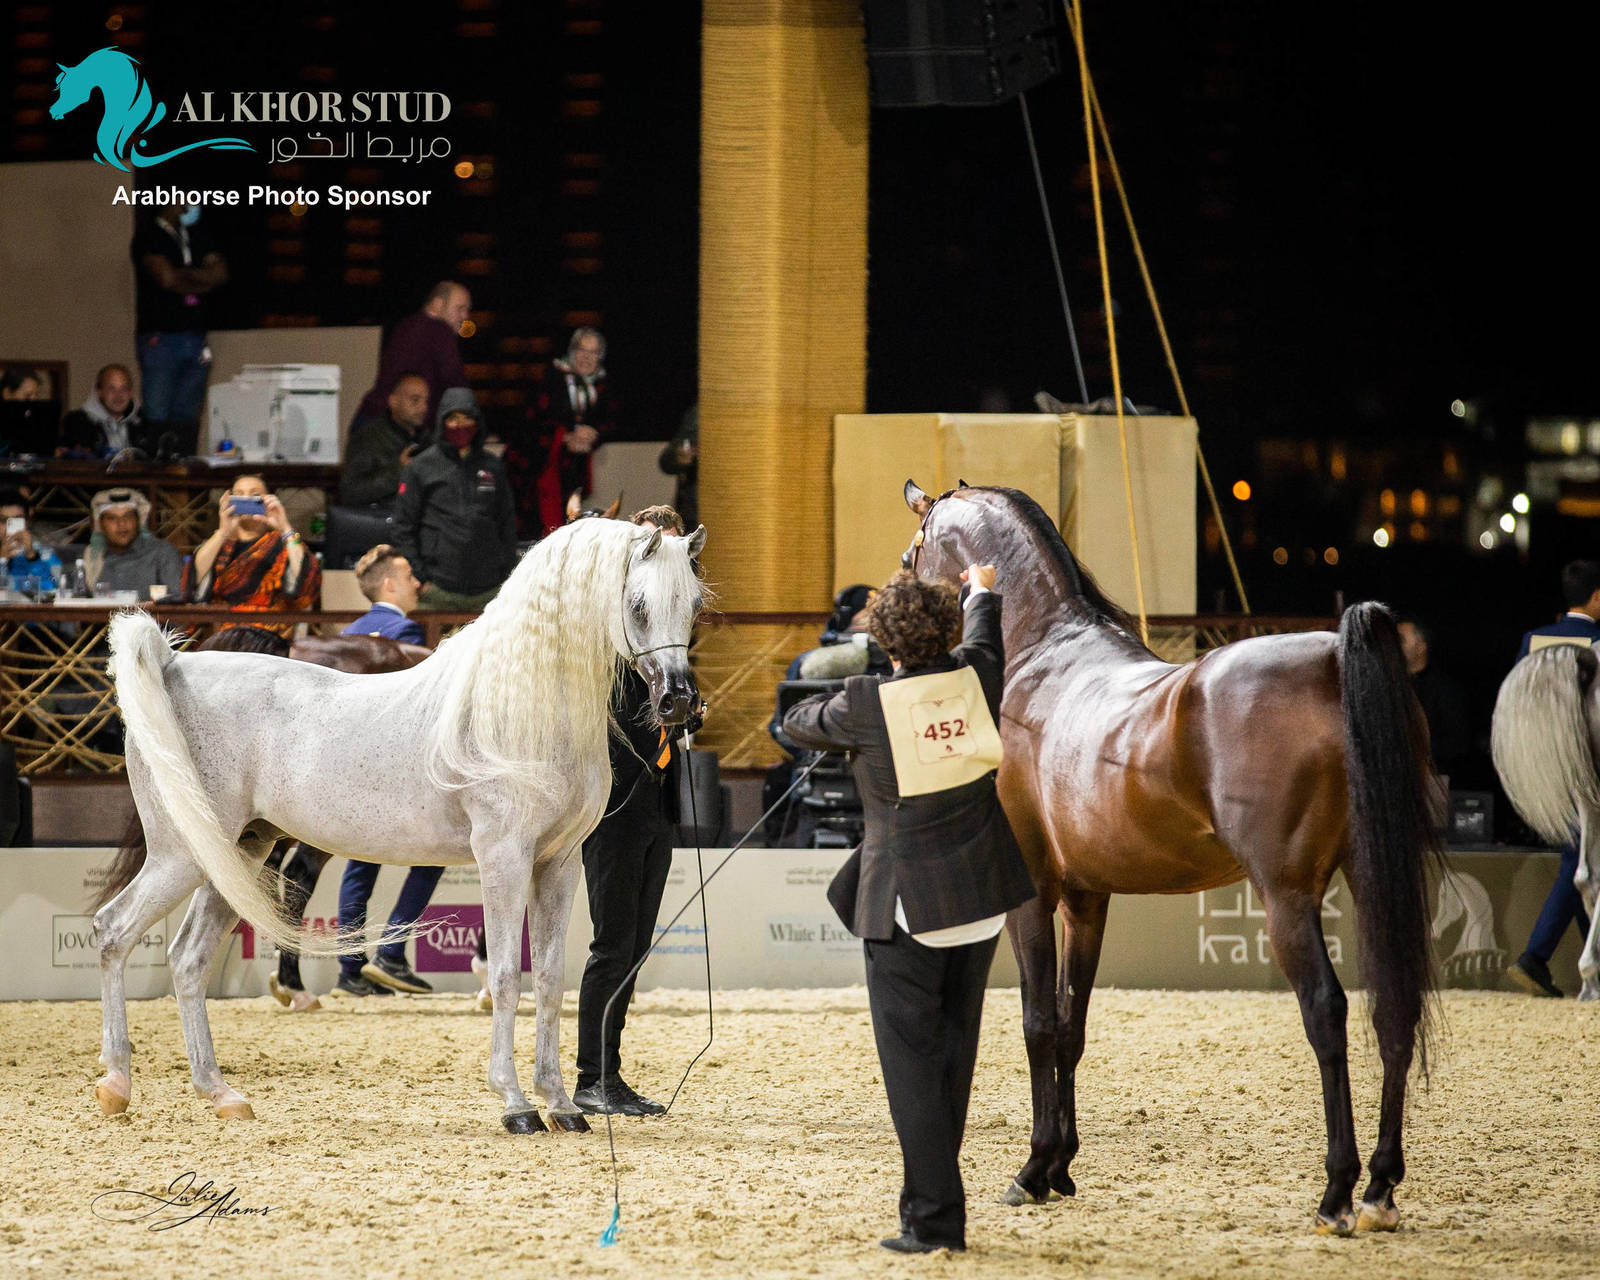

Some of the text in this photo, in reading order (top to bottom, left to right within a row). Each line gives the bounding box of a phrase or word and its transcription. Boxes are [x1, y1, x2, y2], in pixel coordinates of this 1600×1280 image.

[923, 718, 966, 741] 452
[426, 926, 483, 952] QATA
[1199, 925, 1343, 963] kata
